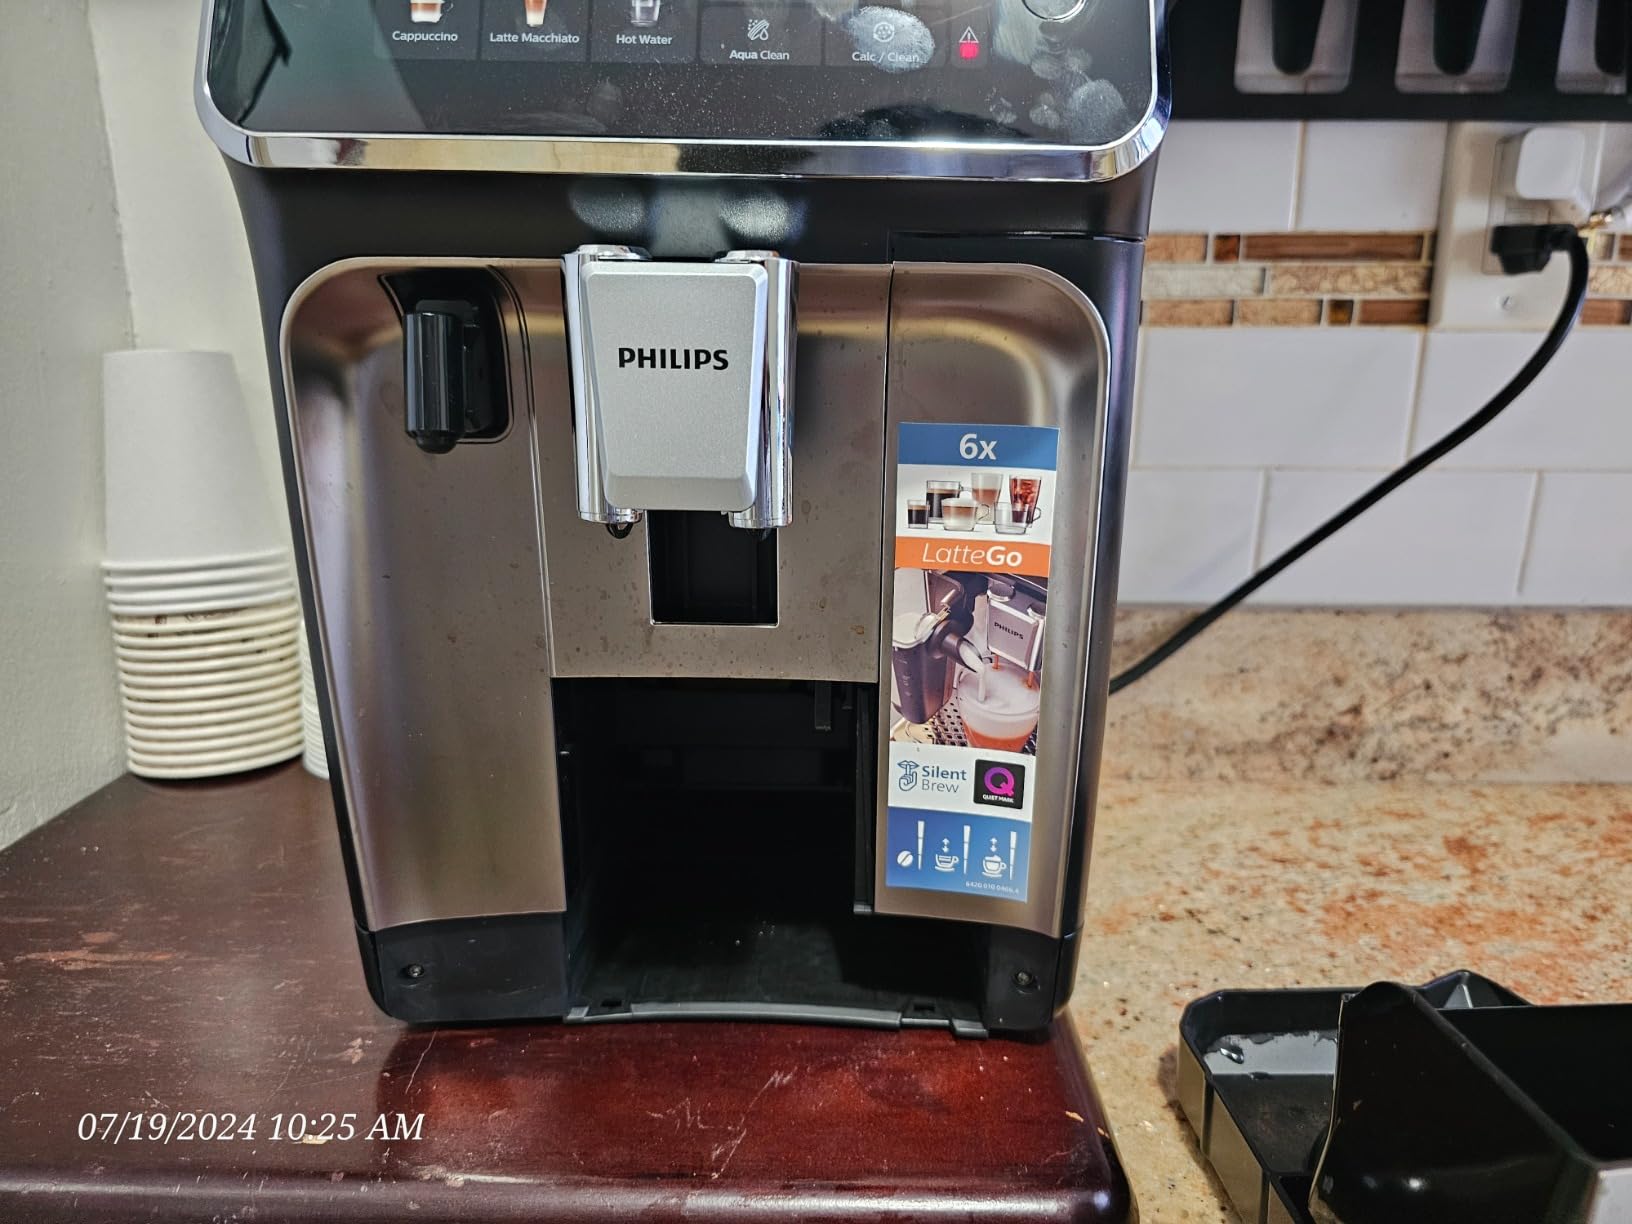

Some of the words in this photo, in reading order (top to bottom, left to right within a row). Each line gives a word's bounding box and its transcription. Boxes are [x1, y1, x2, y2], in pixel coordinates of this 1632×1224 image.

[392, 31, 458, 43] Cappuccino
[489, 32, 519, 44] Latte
[521, 32, 580, 45] Macchiato
[616, 34, 636, 45] Hot
[638, 34, 673, 45] Water
[729, 50, 758, 61] Aqua
[760, 50, 790, 61] Clean
[852, 51, 876, 62] Calc
[887, 52, 920, 63] Clean
[618, 347, 729, 371] PHILIPS
[959, 433, 998, 461] 6x
[922, 543, 1023, 567] LatteGo
[993, 621, 1025, 640] PHILIPS
[921, 765, 968, 781] Silent
[921, 779, 960, 793] Brew
[982, 793, 998, 801] QUIET
[998, 795, 1014, 803] MARK
